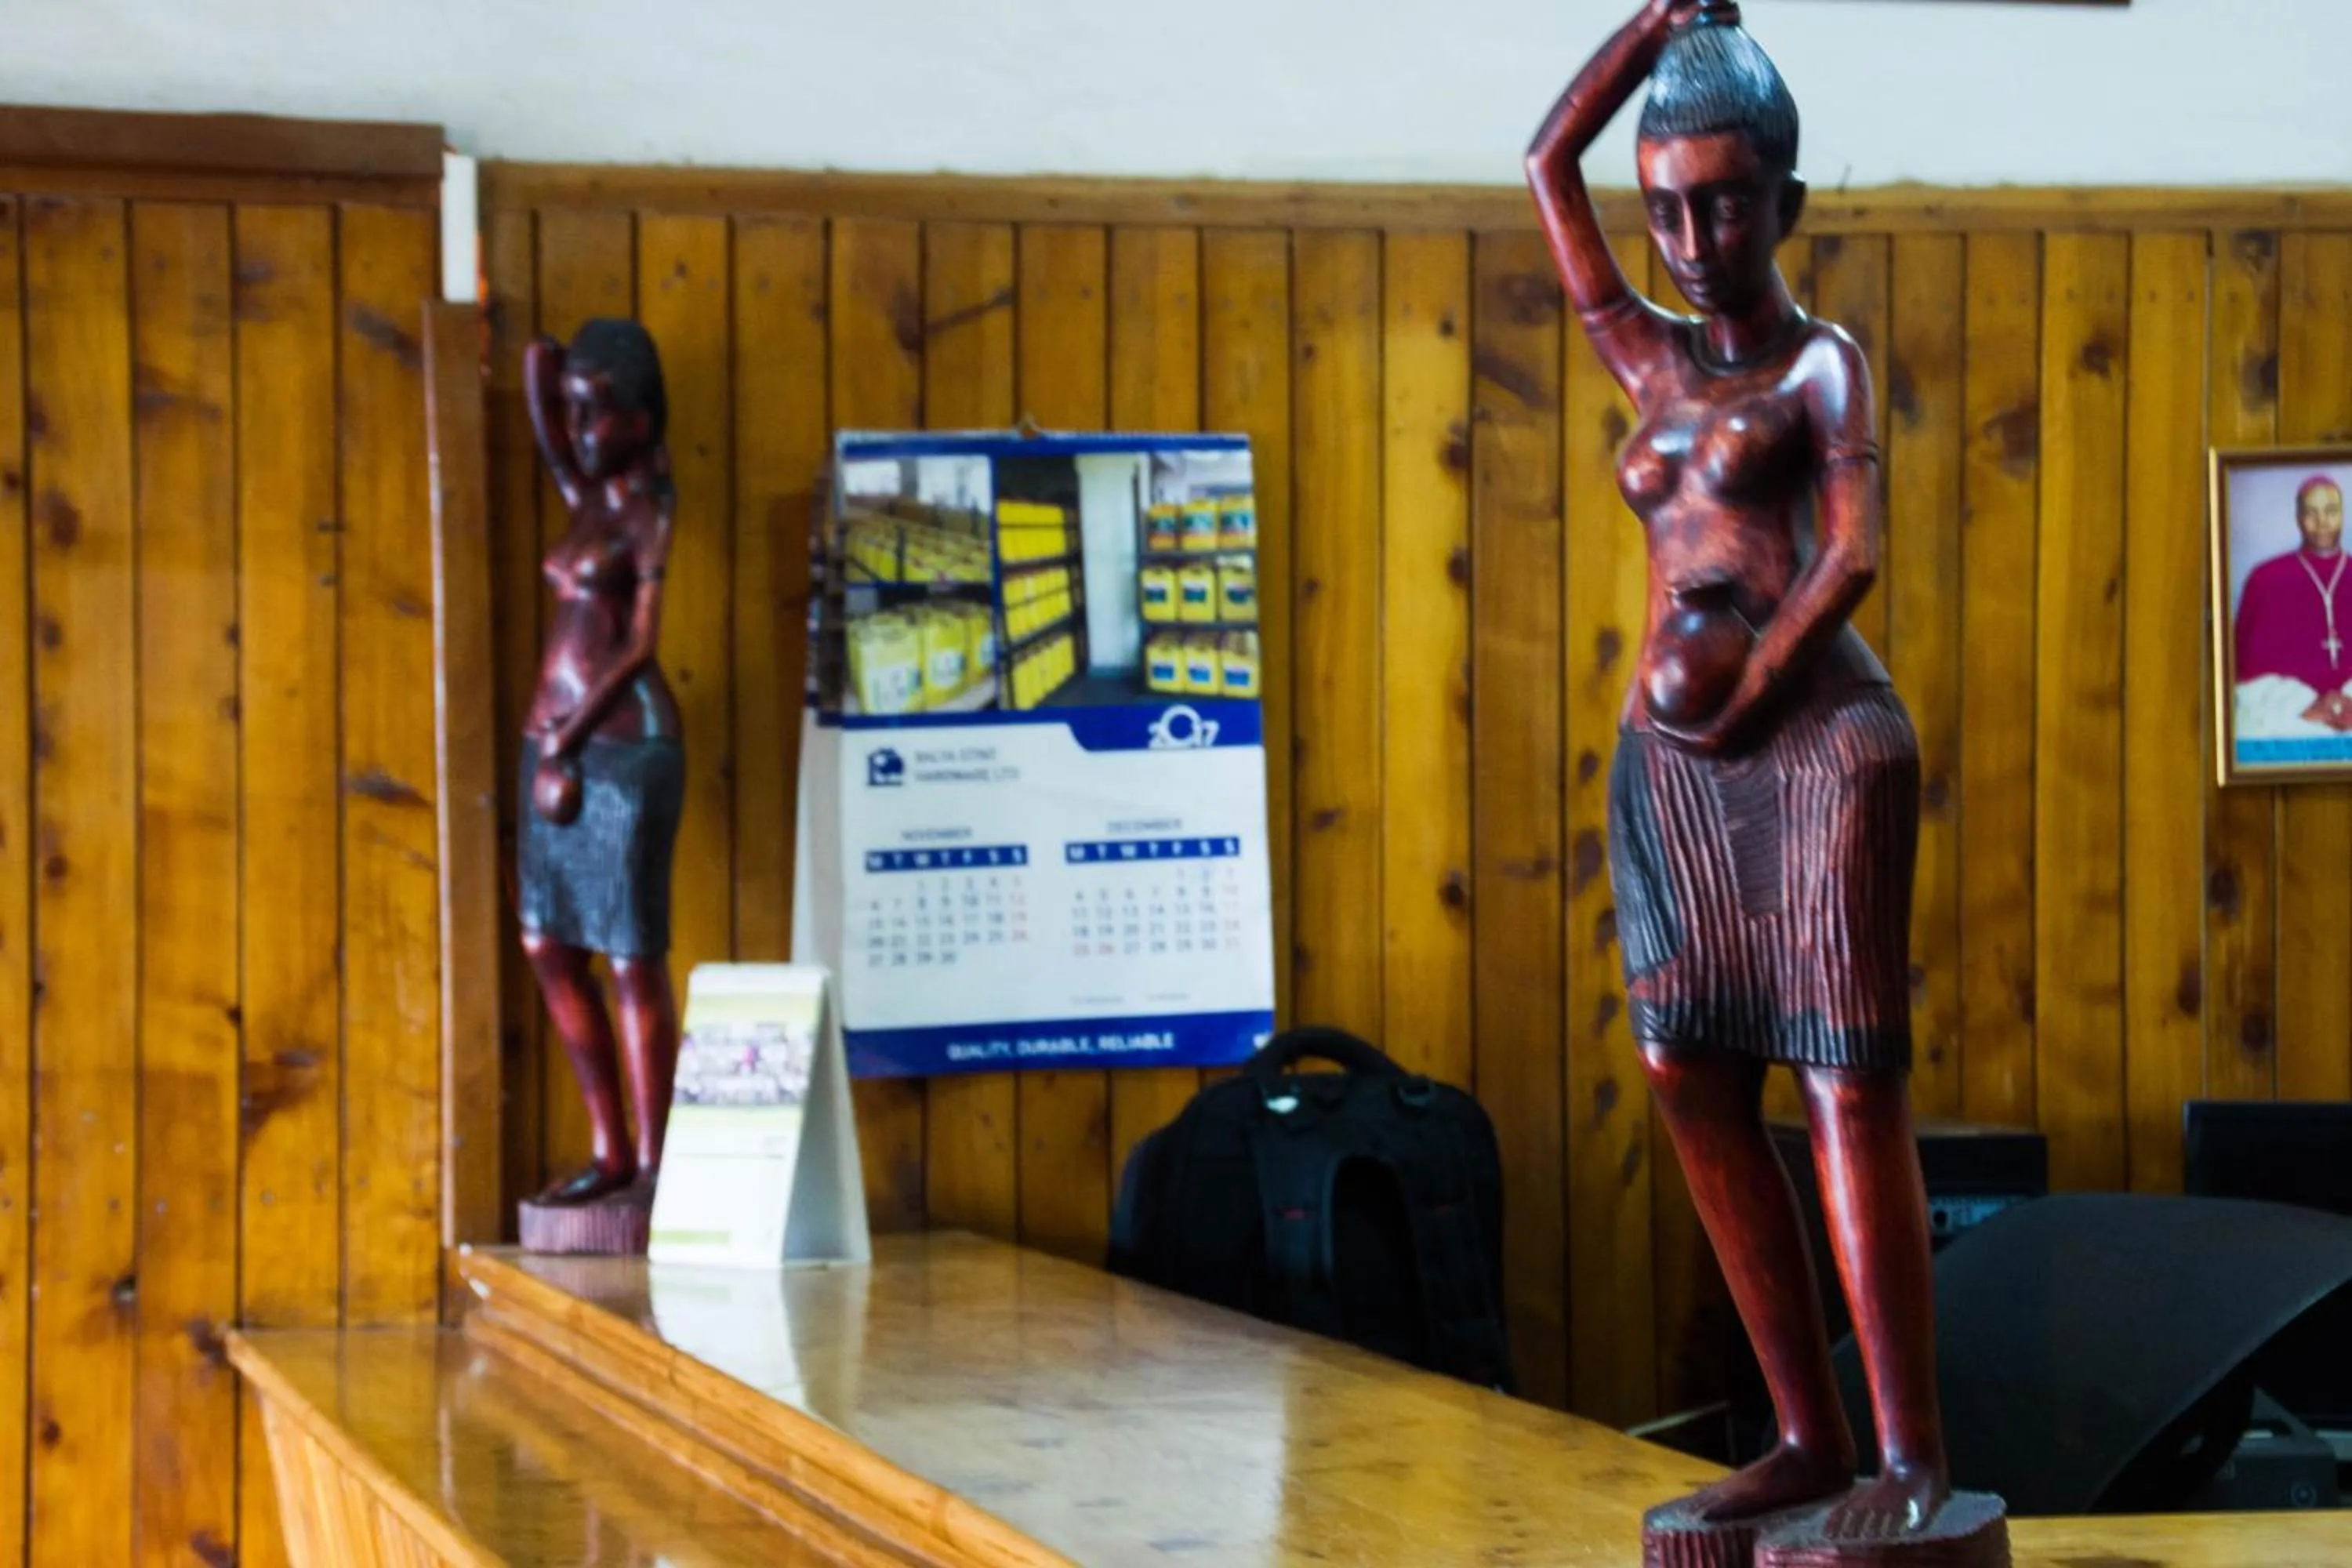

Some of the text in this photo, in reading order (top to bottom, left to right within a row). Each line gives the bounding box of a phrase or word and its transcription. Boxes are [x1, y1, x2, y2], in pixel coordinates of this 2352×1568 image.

[1148, 704, 1220, 750] 2017
[902, 826, 972, 840] NOVEMBER
[1108, 818, 1181, 833] DECEMBER
[869, 854, 883, 869] M
[894, 853, 902, 867] T
[914, 852, 930, 866] W
[941, 850, 949, 864] T
[989, 849, 999, 863] S
[1012, 848, 1022, 861] S
[1070, 845, 1085, 859] M
[1098, 844, 1106, 858] T
[1120, 844, 1136, 857] W
[1149, 842, 1158, 855] T
[1200, 840, 1210, 855] S
[1225, 839, 1235, 853] S
[1098, 1031, 1174, 1051] RELIABLE
